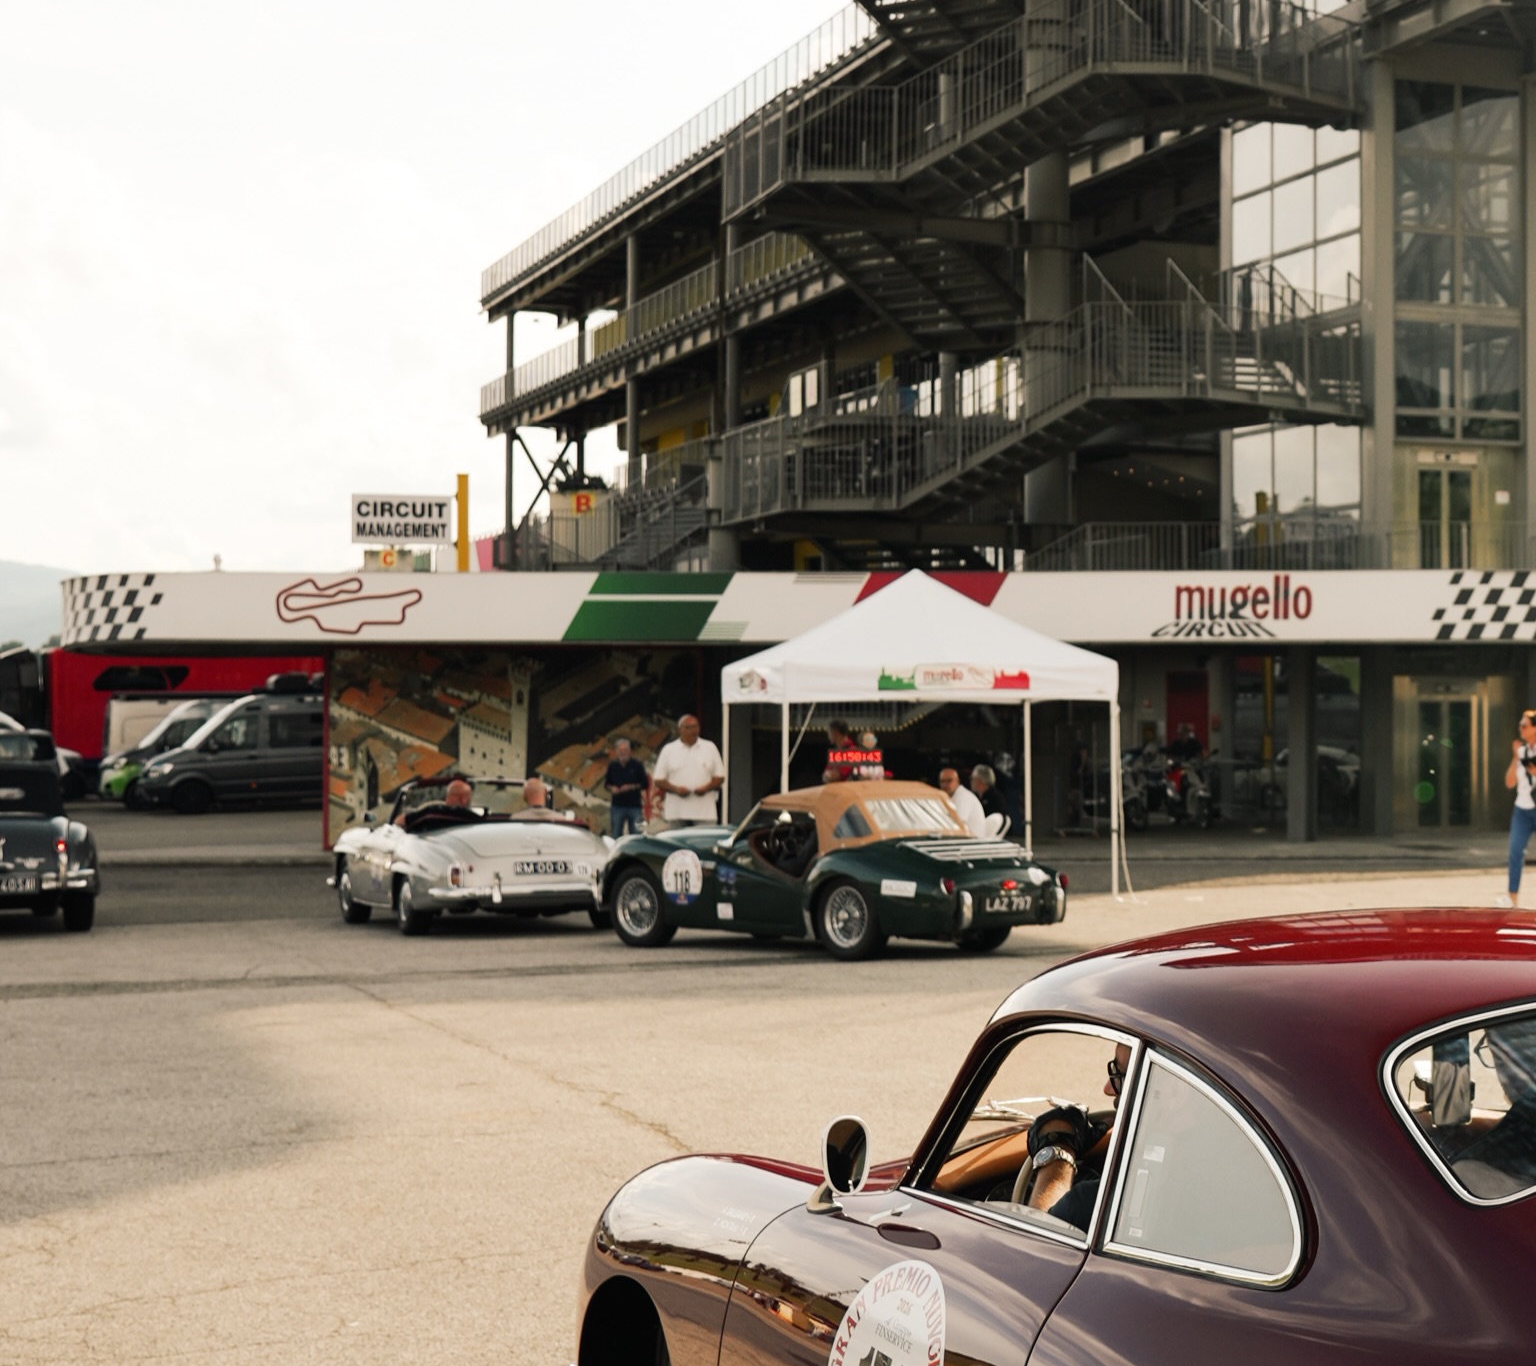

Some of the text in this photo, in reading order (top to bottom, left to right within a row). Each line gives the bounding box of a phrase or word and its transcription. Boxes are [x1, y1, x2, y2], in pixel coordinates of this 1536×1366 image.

[356, 501, 448, 519] CIRCUIT
[575, 493, 592, 514] B
[356, 521, 448, 539] MANAGEMENT
[382, 551, 394, 566] C
[1174, 574, 1313, 622] mugello
[1150, 620, 1277, 638] CIRCUIT
[985, 897, 1009, 913] LAZ
[875, 1322, 914, 1356] FINSERVICE
